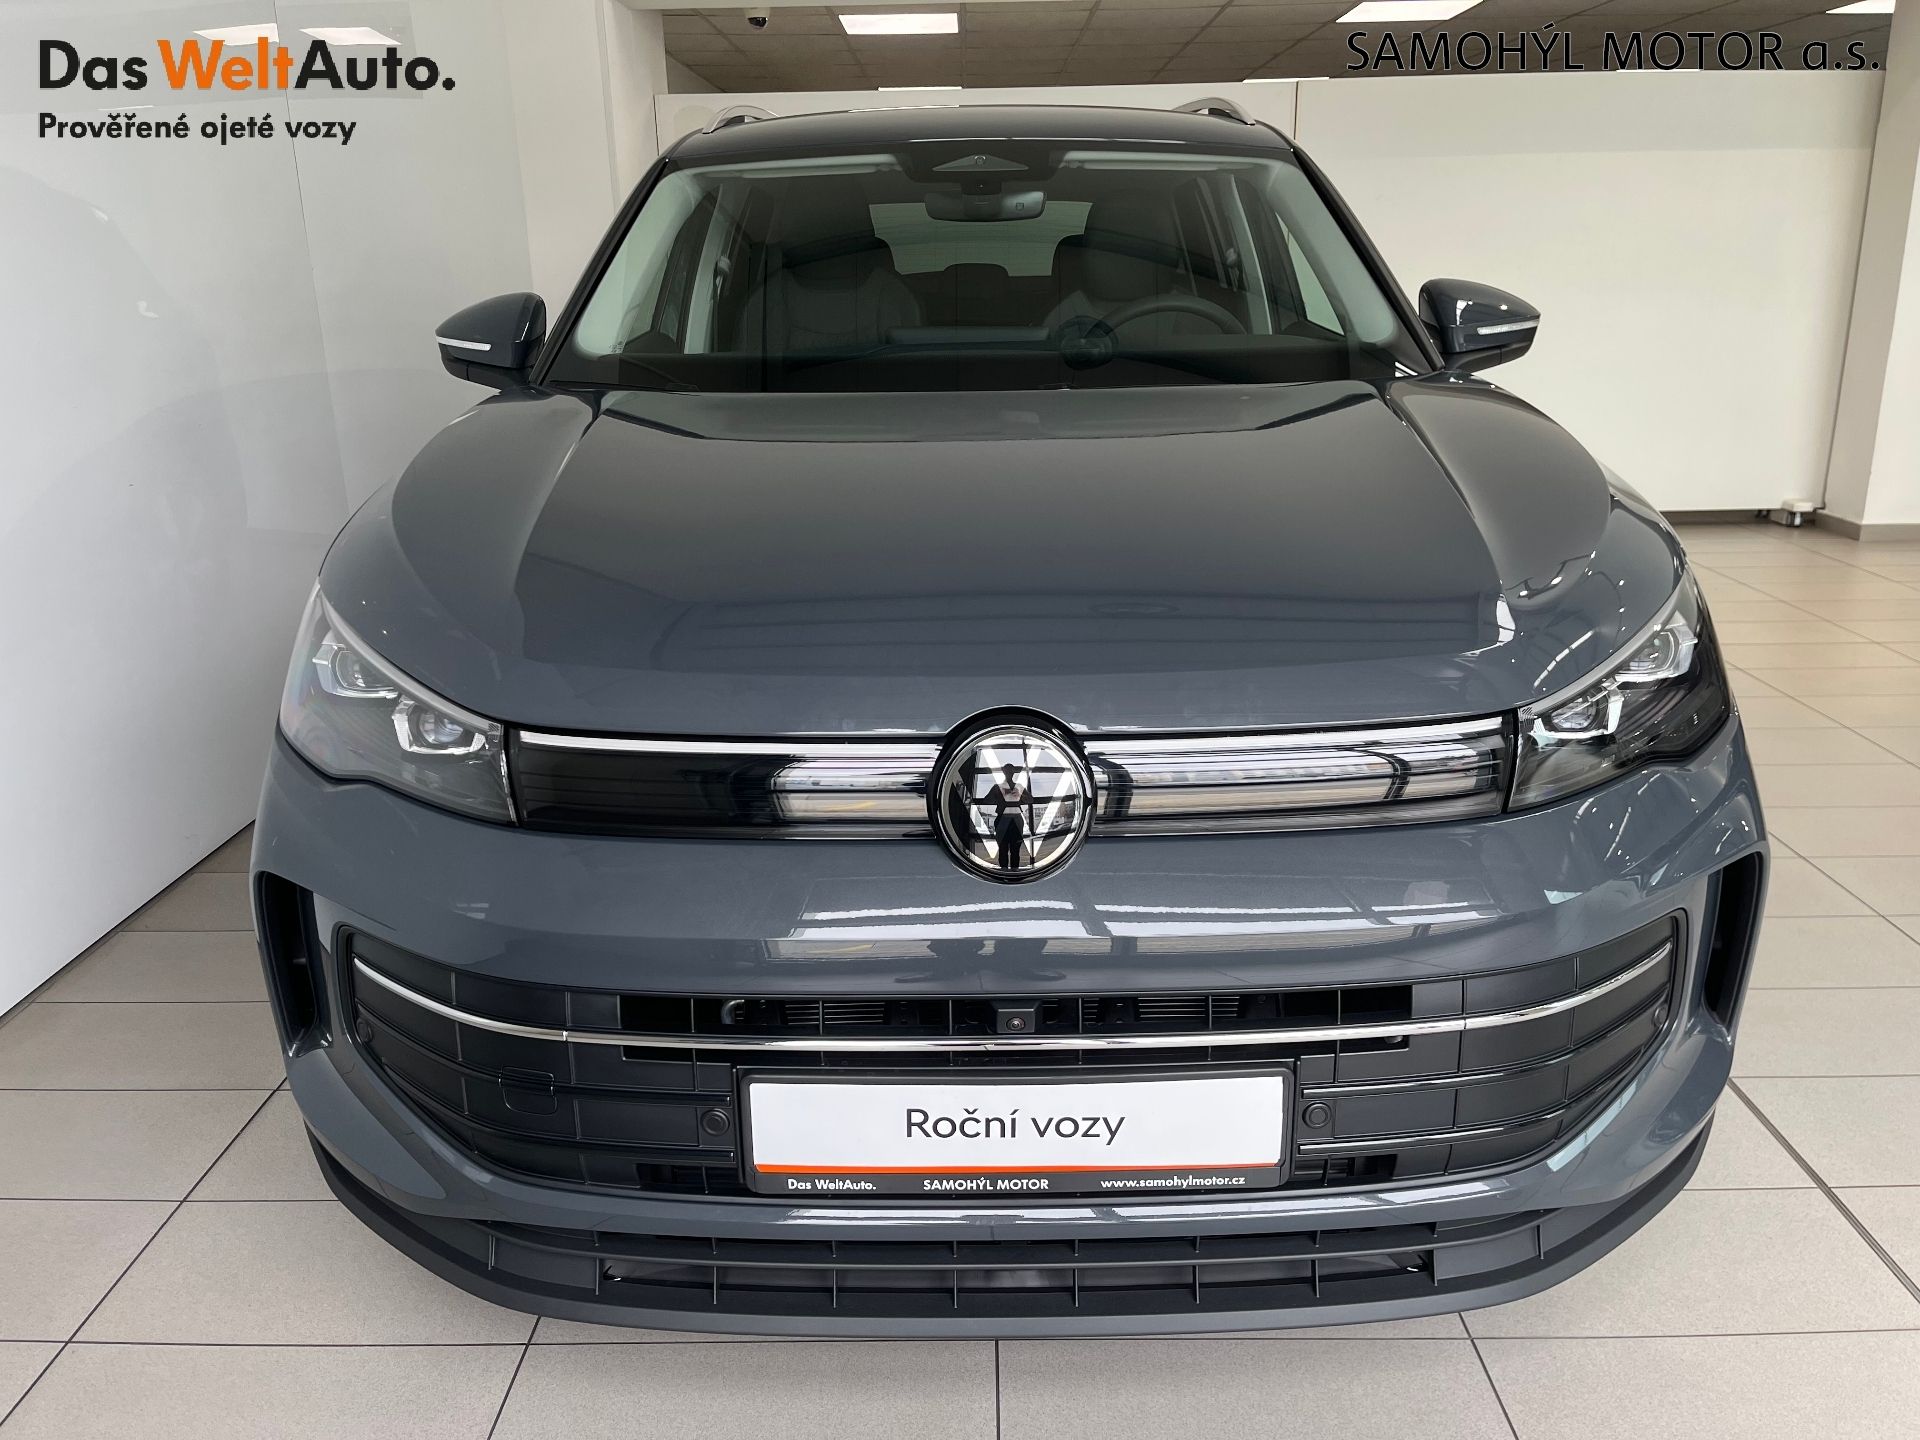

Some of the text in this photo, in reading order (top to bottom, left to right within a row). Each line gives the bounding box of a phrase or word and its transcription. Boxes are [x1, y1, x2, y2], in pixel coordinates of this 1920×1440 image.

[906, 1108, 1125, 1146] Roční vozy
[787, 1178, 877, 1191] Das WeltAuto.
[923, 1176, 1049, 1191] SAMOHÝL MOTOR
[1100, 1175, 1246, 1190] www.samohylmotor.cz
